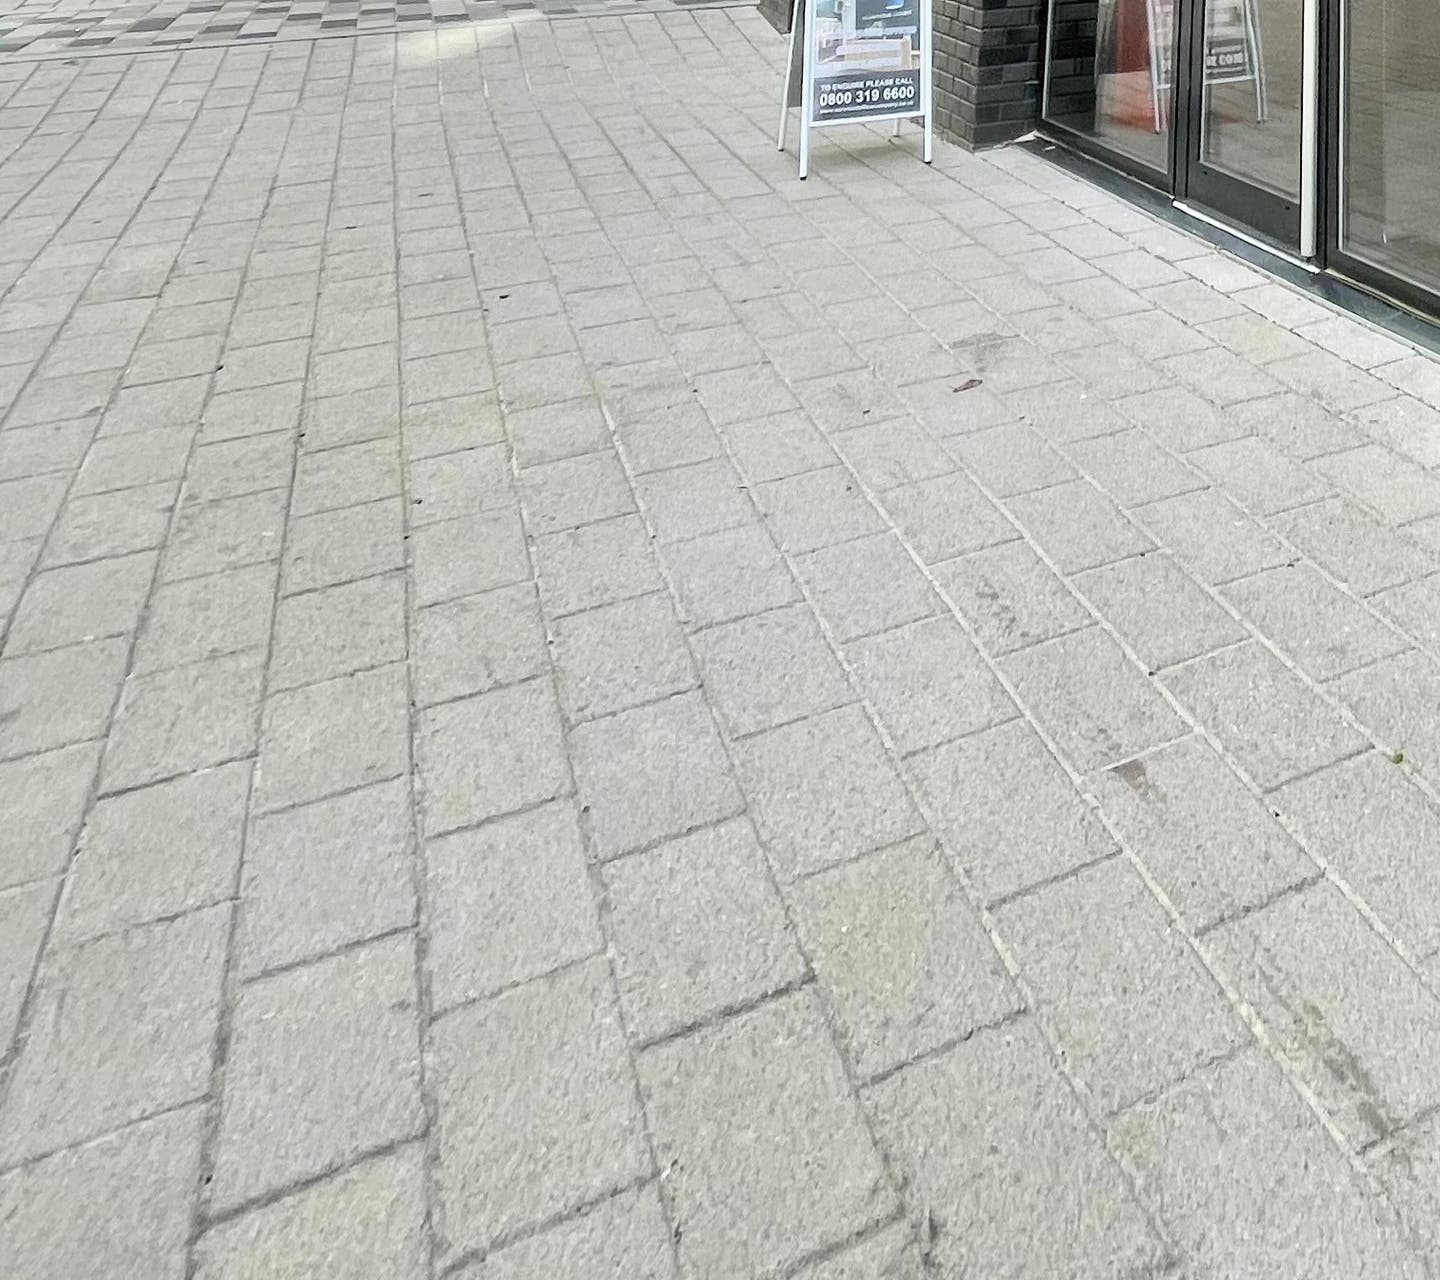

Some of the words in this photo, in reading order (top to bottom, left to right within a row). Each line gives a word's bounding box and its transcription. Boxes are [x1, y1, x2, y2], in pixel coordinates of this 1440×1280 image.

[821, 84, 831, 92] TO
[865, 78, 894, 88] PLEASE
[895, 77, 913, 85] CALL
[820, 91, 852, 107] 0800
[855, 88, 880, 103] 319
[883, 85, 915, 101] 6600
